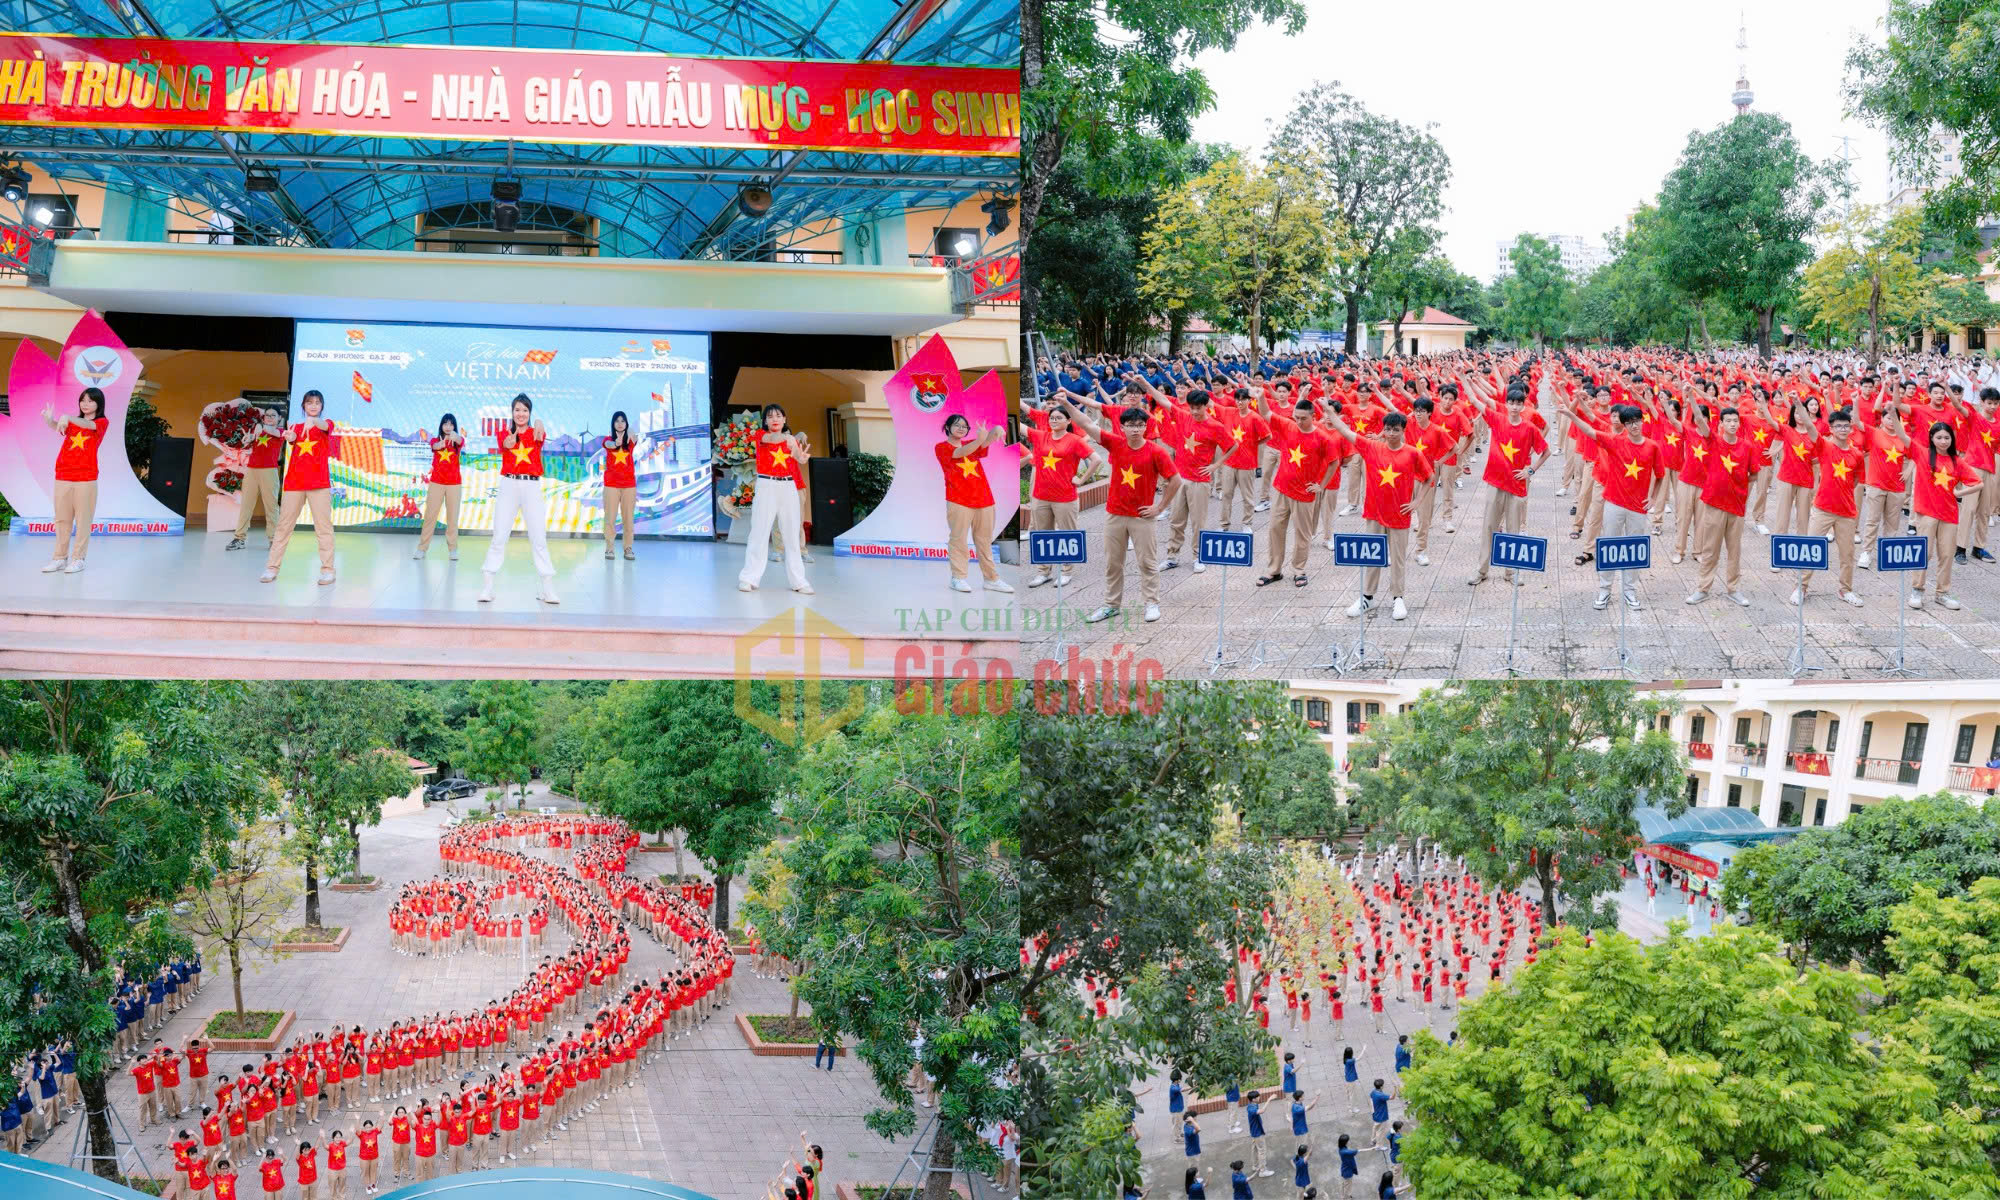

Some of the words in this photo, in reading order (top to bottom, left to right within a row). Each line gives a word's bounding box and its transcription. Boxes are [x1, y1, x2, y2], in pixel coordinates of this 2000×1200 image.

[60, 50, 213, 111] TRƯỜNG
[225, 55, 303, 113] VĂN
[312, 60, 391, 118] HÓA
[431, 66, 510, 122] NHÀ
[524, 68, 613, 127] GIÁO
[626, 65, 712, 128] MẪU
[723, 81, 812, 140] MỰC
[845, 87, 922, 144] HỌC
[931, 89, 1020, 138] SINH
[107, 522, 144, 533] TRUNG
[894, 545, 919, 557] THPT
[1037, 538, 1079, 557] 11A6
[1205, 538, 1246, 559] 11A3
[1340, 541, 1381, 560] 11A2
[1498, 541, 1538, 563] 11A1
[1600, 543, 1647, 563] 10A10
[1778, 543, 1822, 562] 10A9
[1885, 544, 1923, 563] 10A7
